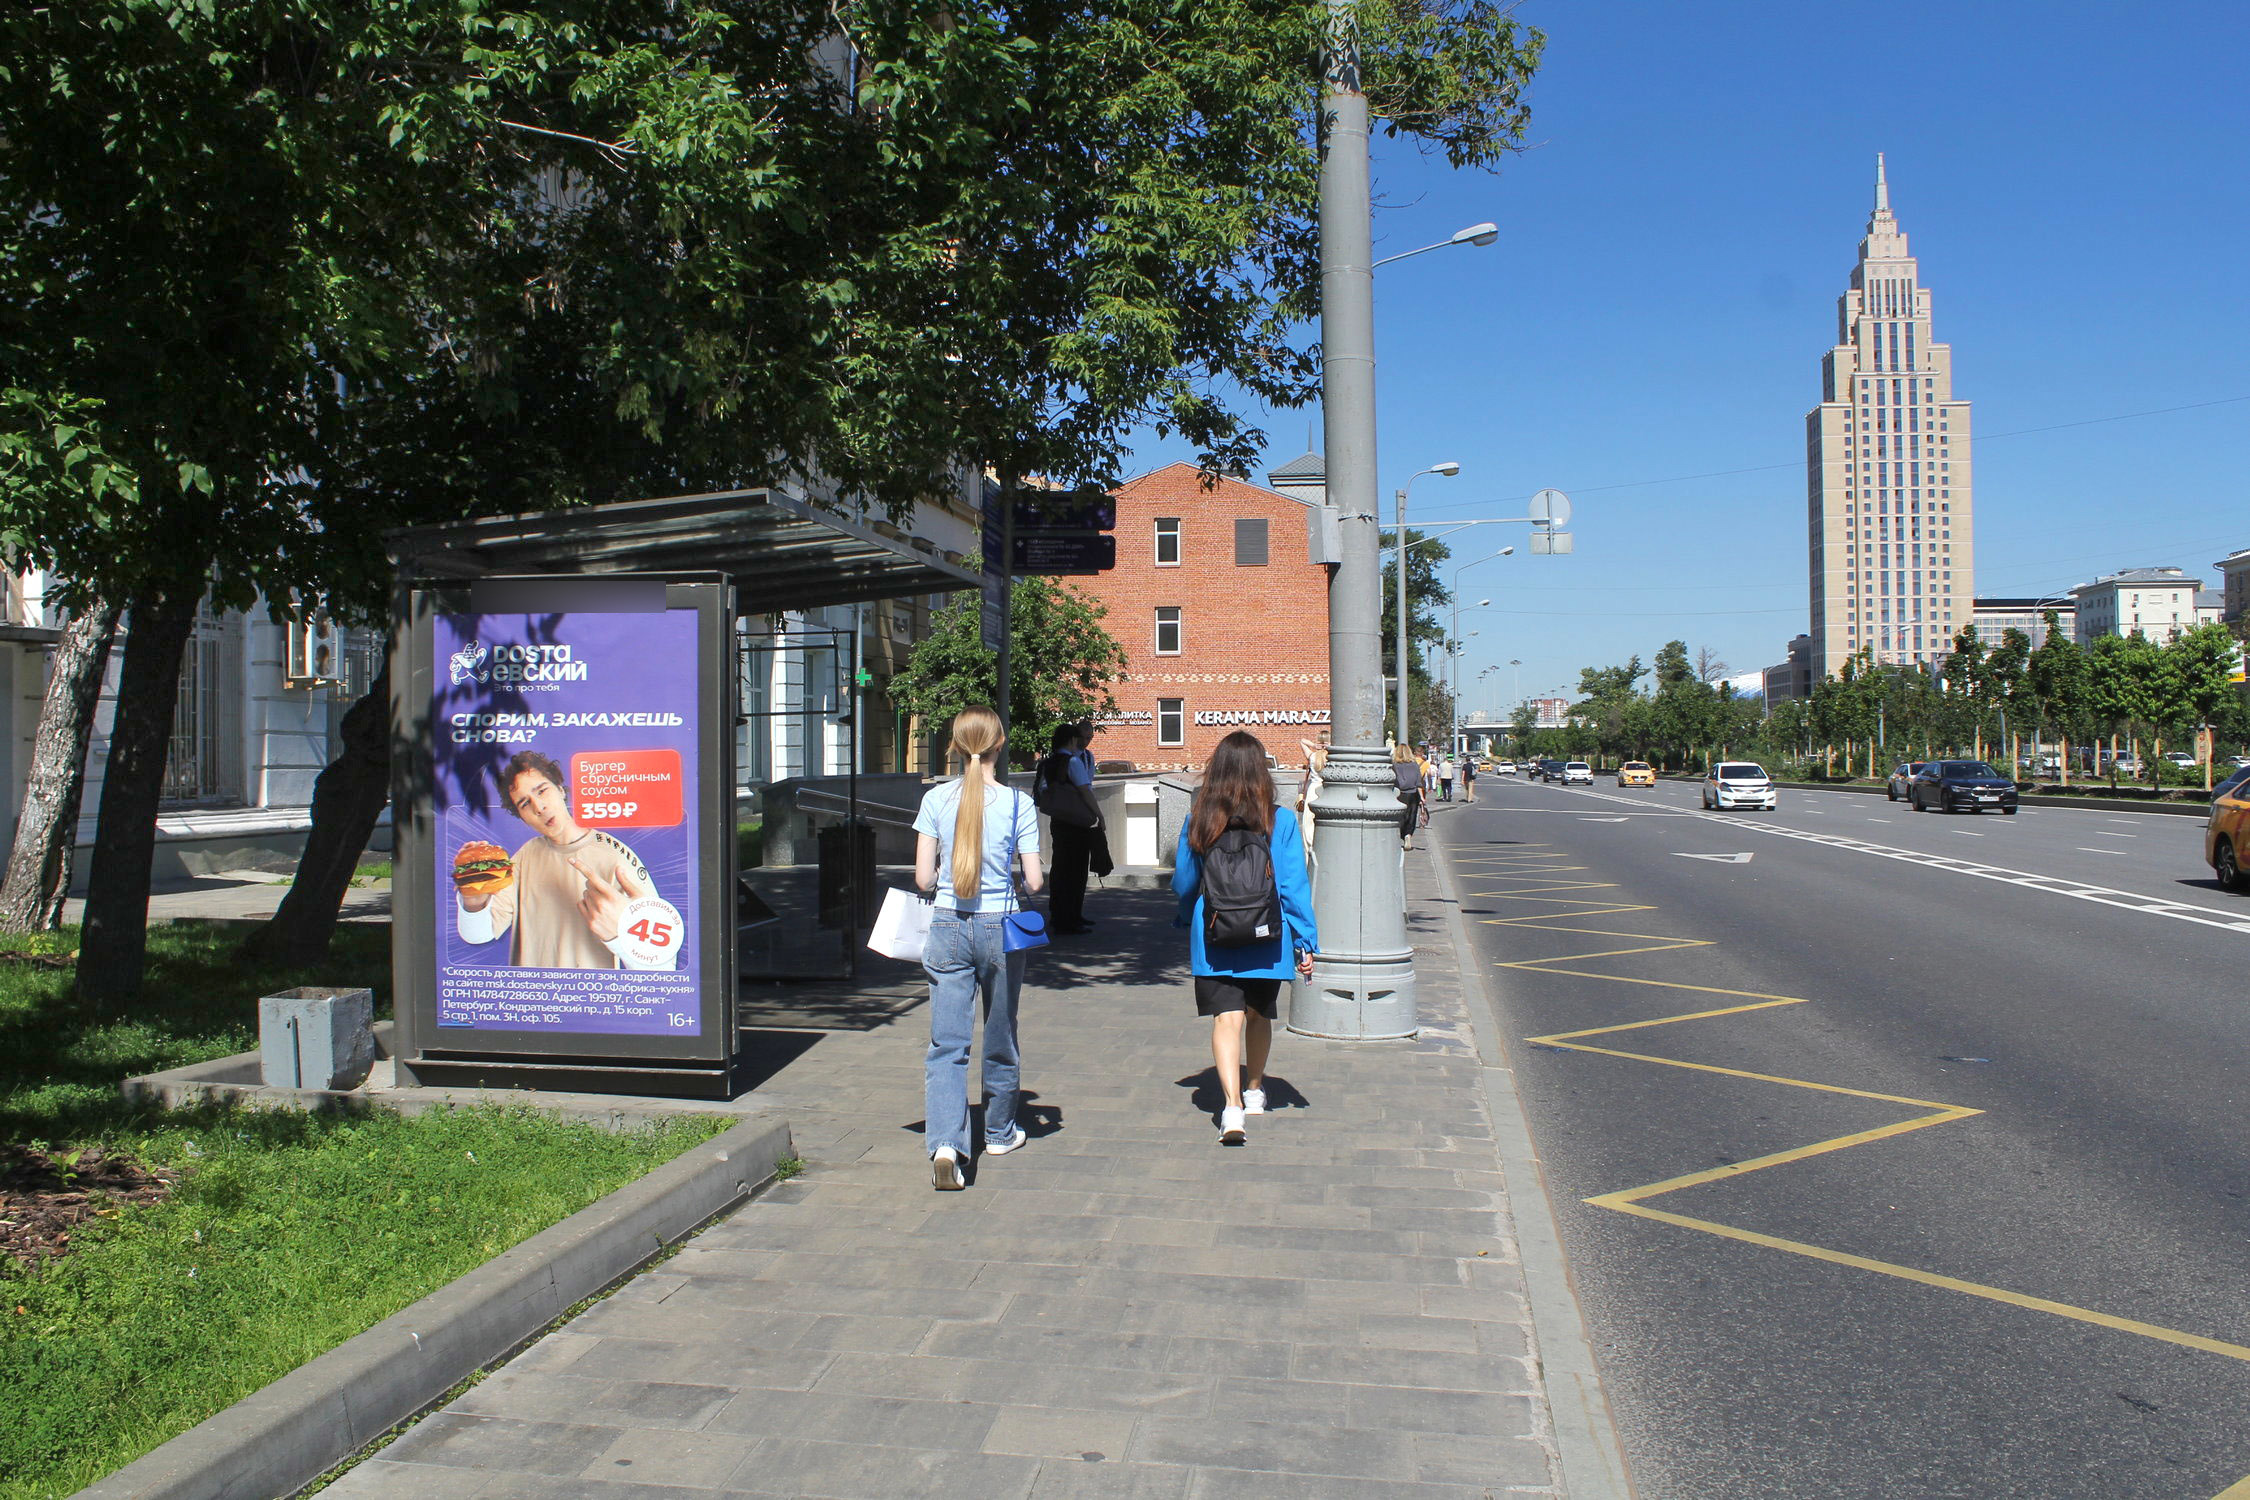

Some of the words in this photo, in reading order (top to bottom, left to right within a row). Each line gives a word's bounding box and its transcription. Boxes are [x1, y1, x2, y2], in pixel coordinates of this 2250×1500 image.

[494, 683, 513, 692] Это
[514, 684, 534, 694] про
[535, 682, 560, 692] тебя
[451, 712, 549, 729] СПОРИМ,
[551, 712, 684, 728] ЗАКАЖЕШЬ
[1194, 710, 1261, 725] KERAMA
[450, 729, 537, 743] СНОВА?
[580, 761, 626, 775] Бургер
[580, 774, 588, 784] с
[589, 772, 671, 786] брусничным
[581, 786, 628, 798] соусом
[581, 802, 638, 819] 359₽
[628, 899, 674, 915] Доставим
[627, 918, 673, 947] 45
[631, 949, 659, 963] минут
[493, 970, 540, 979] доставки
[541, 971, 583, 980] зависит
[597, 973, 619, 981] зон,
[620, 972, 690, 983] подробности
[442, 979, 455, 987] на
[455, 979, 484, 988] сайте
[485, 980, 576, 993] msk.dostaevsky.ru
[577, 982, 603, 991] ООО
[442, 988, 471, 998] ОГРН
[588, 993, 624, 1004] 195197,
[498, 1001, 582, 1013] Кондратьевский
[614, 1005, 625, 1015] 15
[626, 1007, 654, 1017] корп.
[443, 1010, 450, 1019] 5
[521, 1014, 541, 1024] оф.
[667, 1012, 696, 1027] 16+
